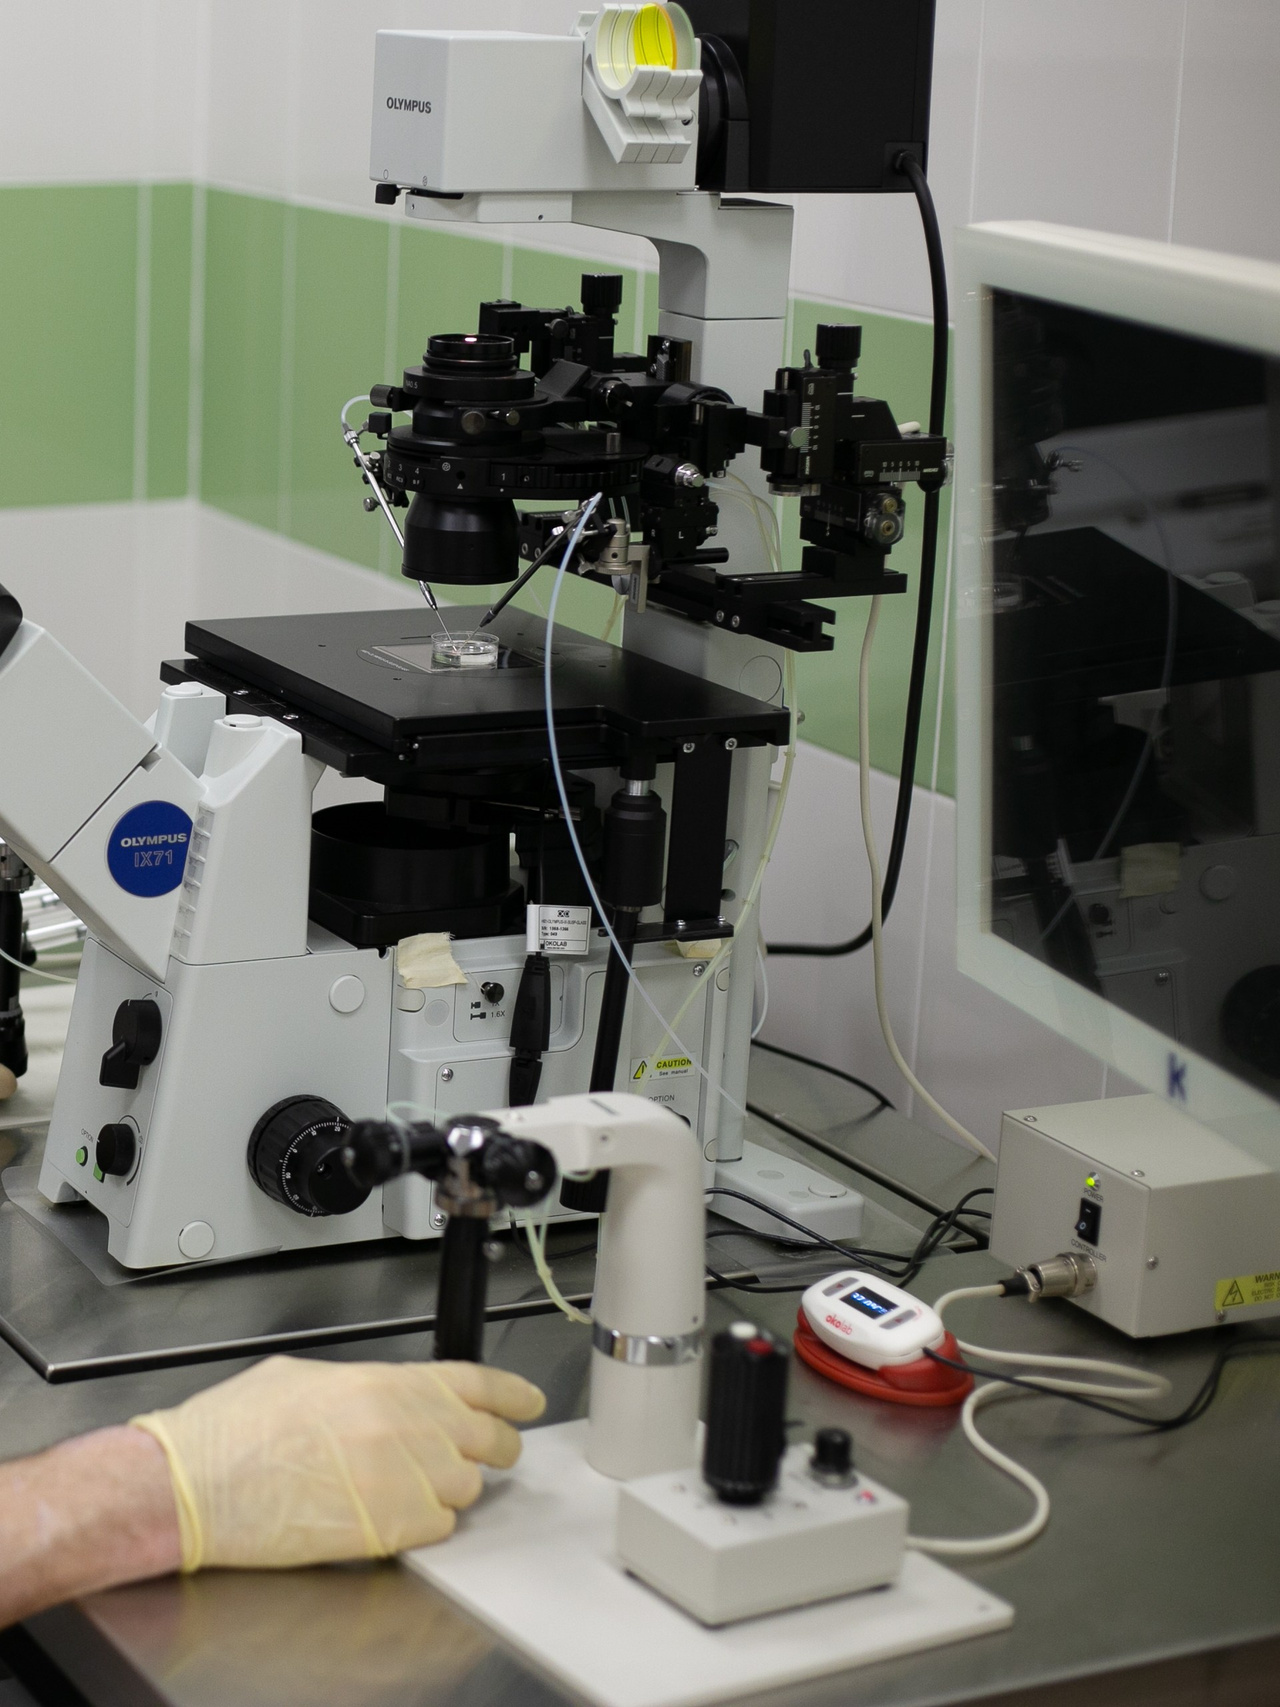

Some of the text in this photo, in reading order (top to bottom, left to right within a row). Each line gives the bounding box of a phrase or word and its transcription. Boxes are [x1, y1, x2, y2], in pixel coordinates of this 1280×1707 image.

[386, 97, 431, 114] OLYMPUS
[398, 463, 403, 471] 3
[414, 467, 420, 475] 4
[678, 531, 684, 539] L
[120, 833, 188, 847] OLYMPUS
[134, 849, 173, 868] IX71
[491, 1010, 506, 1018] 1.6X
[656, 1058, 692, 1069] CAUTION
[1083, 1187, 1104, 1203] POWER
[1071, 1238, 1107, 1263] CONTROLLER
[825, 1313, 853, 1335] okolab
